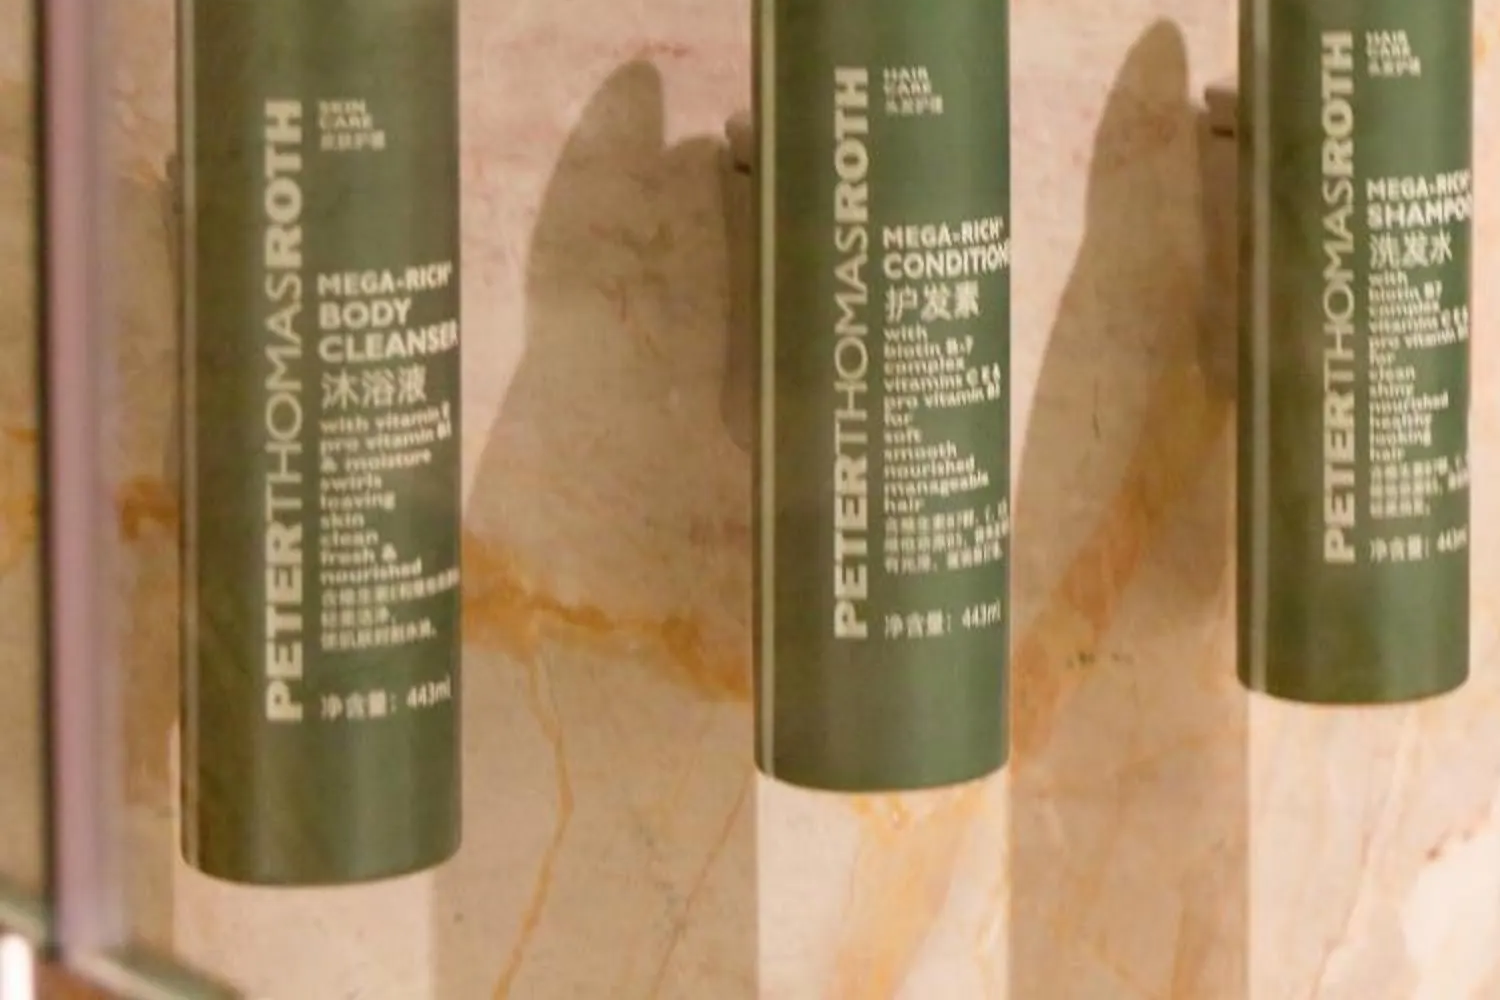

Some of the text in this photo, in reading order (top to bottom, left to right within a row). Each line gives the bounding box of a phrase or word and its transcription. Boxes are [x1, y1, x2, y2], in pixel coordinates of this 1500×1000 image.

[883, 67, 929, 82] HAIR
[319, 114, 373, 130] CARE
[885, 280, 979, 323] 护发素
[1321, 32, 1354, 563] PETERTHOMASROTH
[319, 298, 411, 330] BODY
[318, 319, 458, 363] CLEANSER
[883, 322, 928, 342] with
[834, 67, 869, 639] PETERTHOMASROTH
[884, 342, 941, 360] biotin
[884, 356, 964, 378] complex
[321, 362, 427, 412] 沐浴液
[264, 98, 303, 720] PETERTHOMASROTH
[884, 395, 918, 413] pro
[924, 387, 985, 408] vitamin
[884, 426, 922, 443] soft
[345, 448, 432, 472] moisture
[884, 440, 957, 461] smooth
[884, 454, 975, 479] nourished
[320, 491, 395, 511] leaving
[884, 496, 924, 513] hair
[320, 513, 365, 530] skin
[320, 530, 378, 548] clean
[320, 549, 375, 566] fresh
[320, 556, 422, 586] nourished
[406, 673, 451, 709] 443ml
